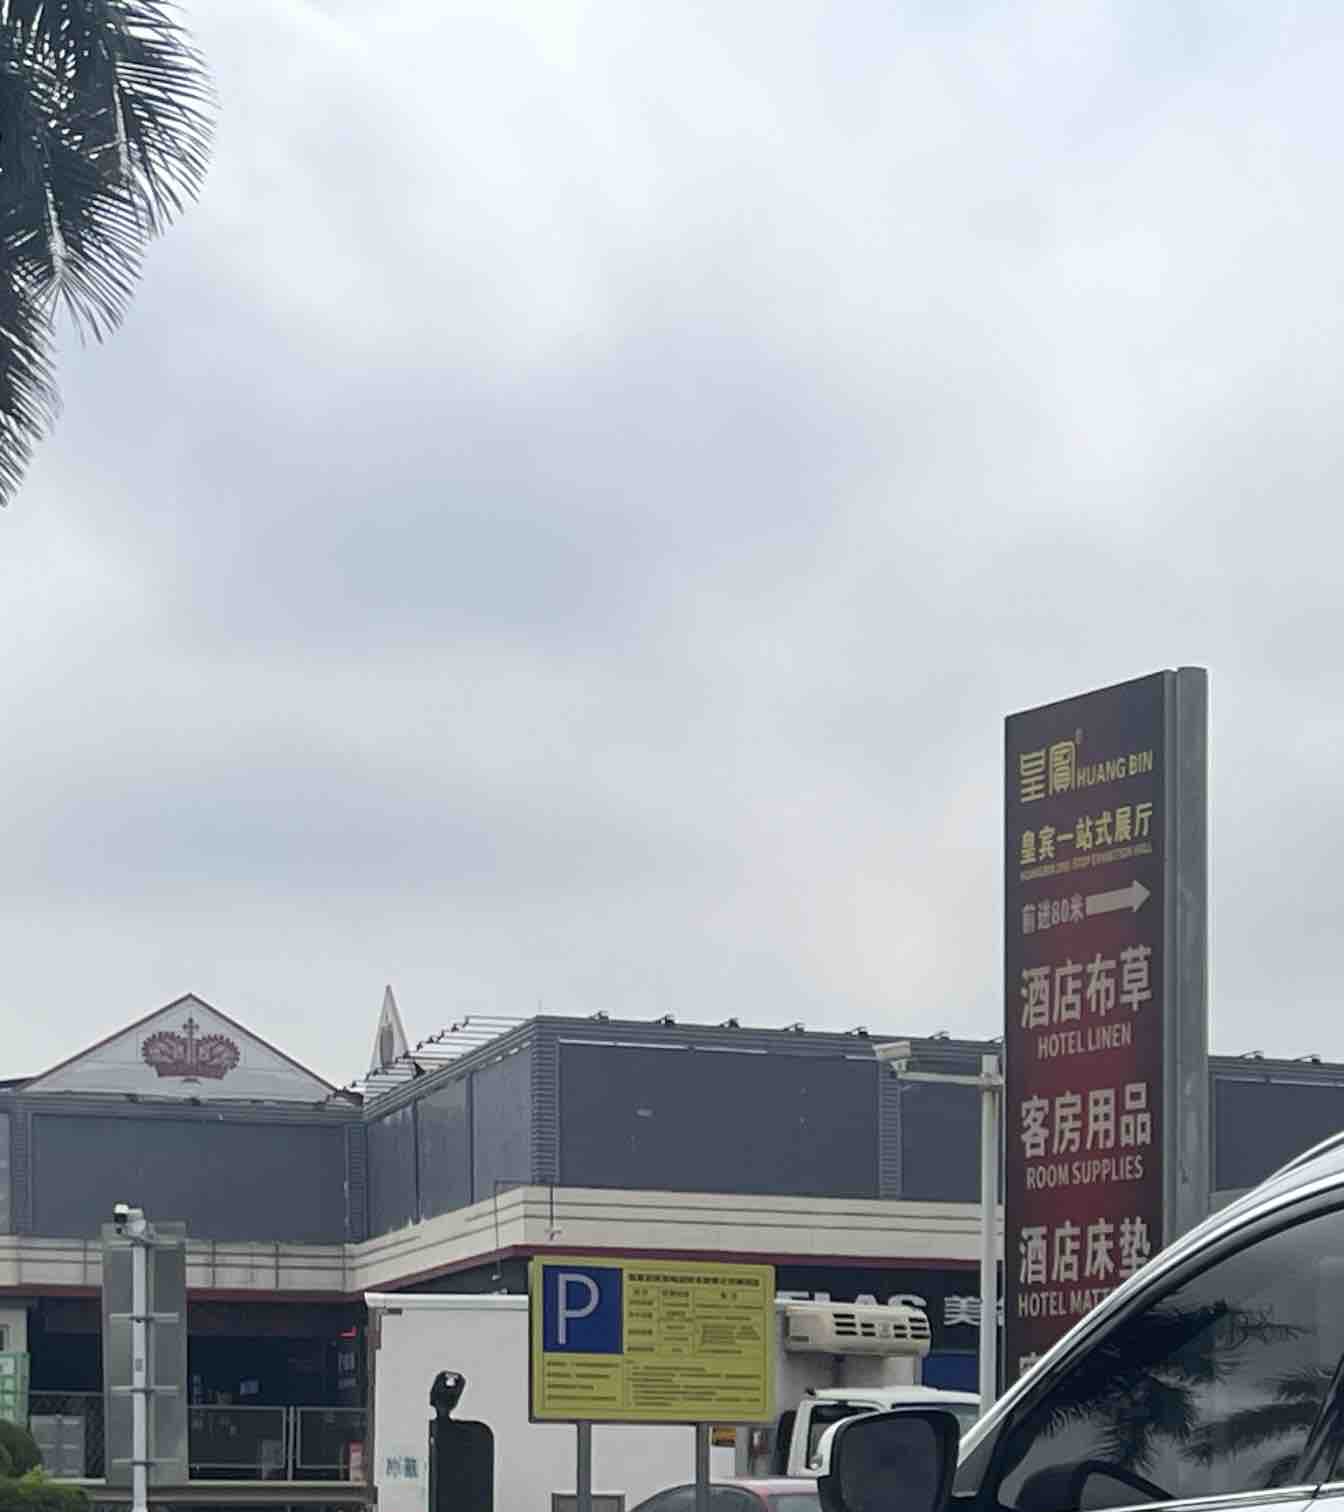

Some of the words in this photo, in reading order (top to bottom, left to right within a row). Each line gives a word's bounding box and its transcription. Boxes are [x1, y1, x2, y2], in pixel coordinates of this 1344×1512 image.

[1077, 757, 1127, 787] HUANG
[1128, 750, 1153, 774] BIN
[1019, 802, 1153, 866] 皇宾一站式展厅
[1020, 944, 1152, 1030] 酒店布草
[1037, 1032, 1087, 1060] HOTEL
[1088, 1022, 1132, 1052] LINEN
[1020, 1082, 1152, 1159] 客房用品
[1026, 1163, 1069, 1190] ROOM
[1070, 1154, 1144, 1184] SUPPLIES
[1018, 1215, 1151, 1285] 酒店床垫
[557, 1273, 600, 1345] P
[1018, 1291, 1067, 1318] HOTEL
